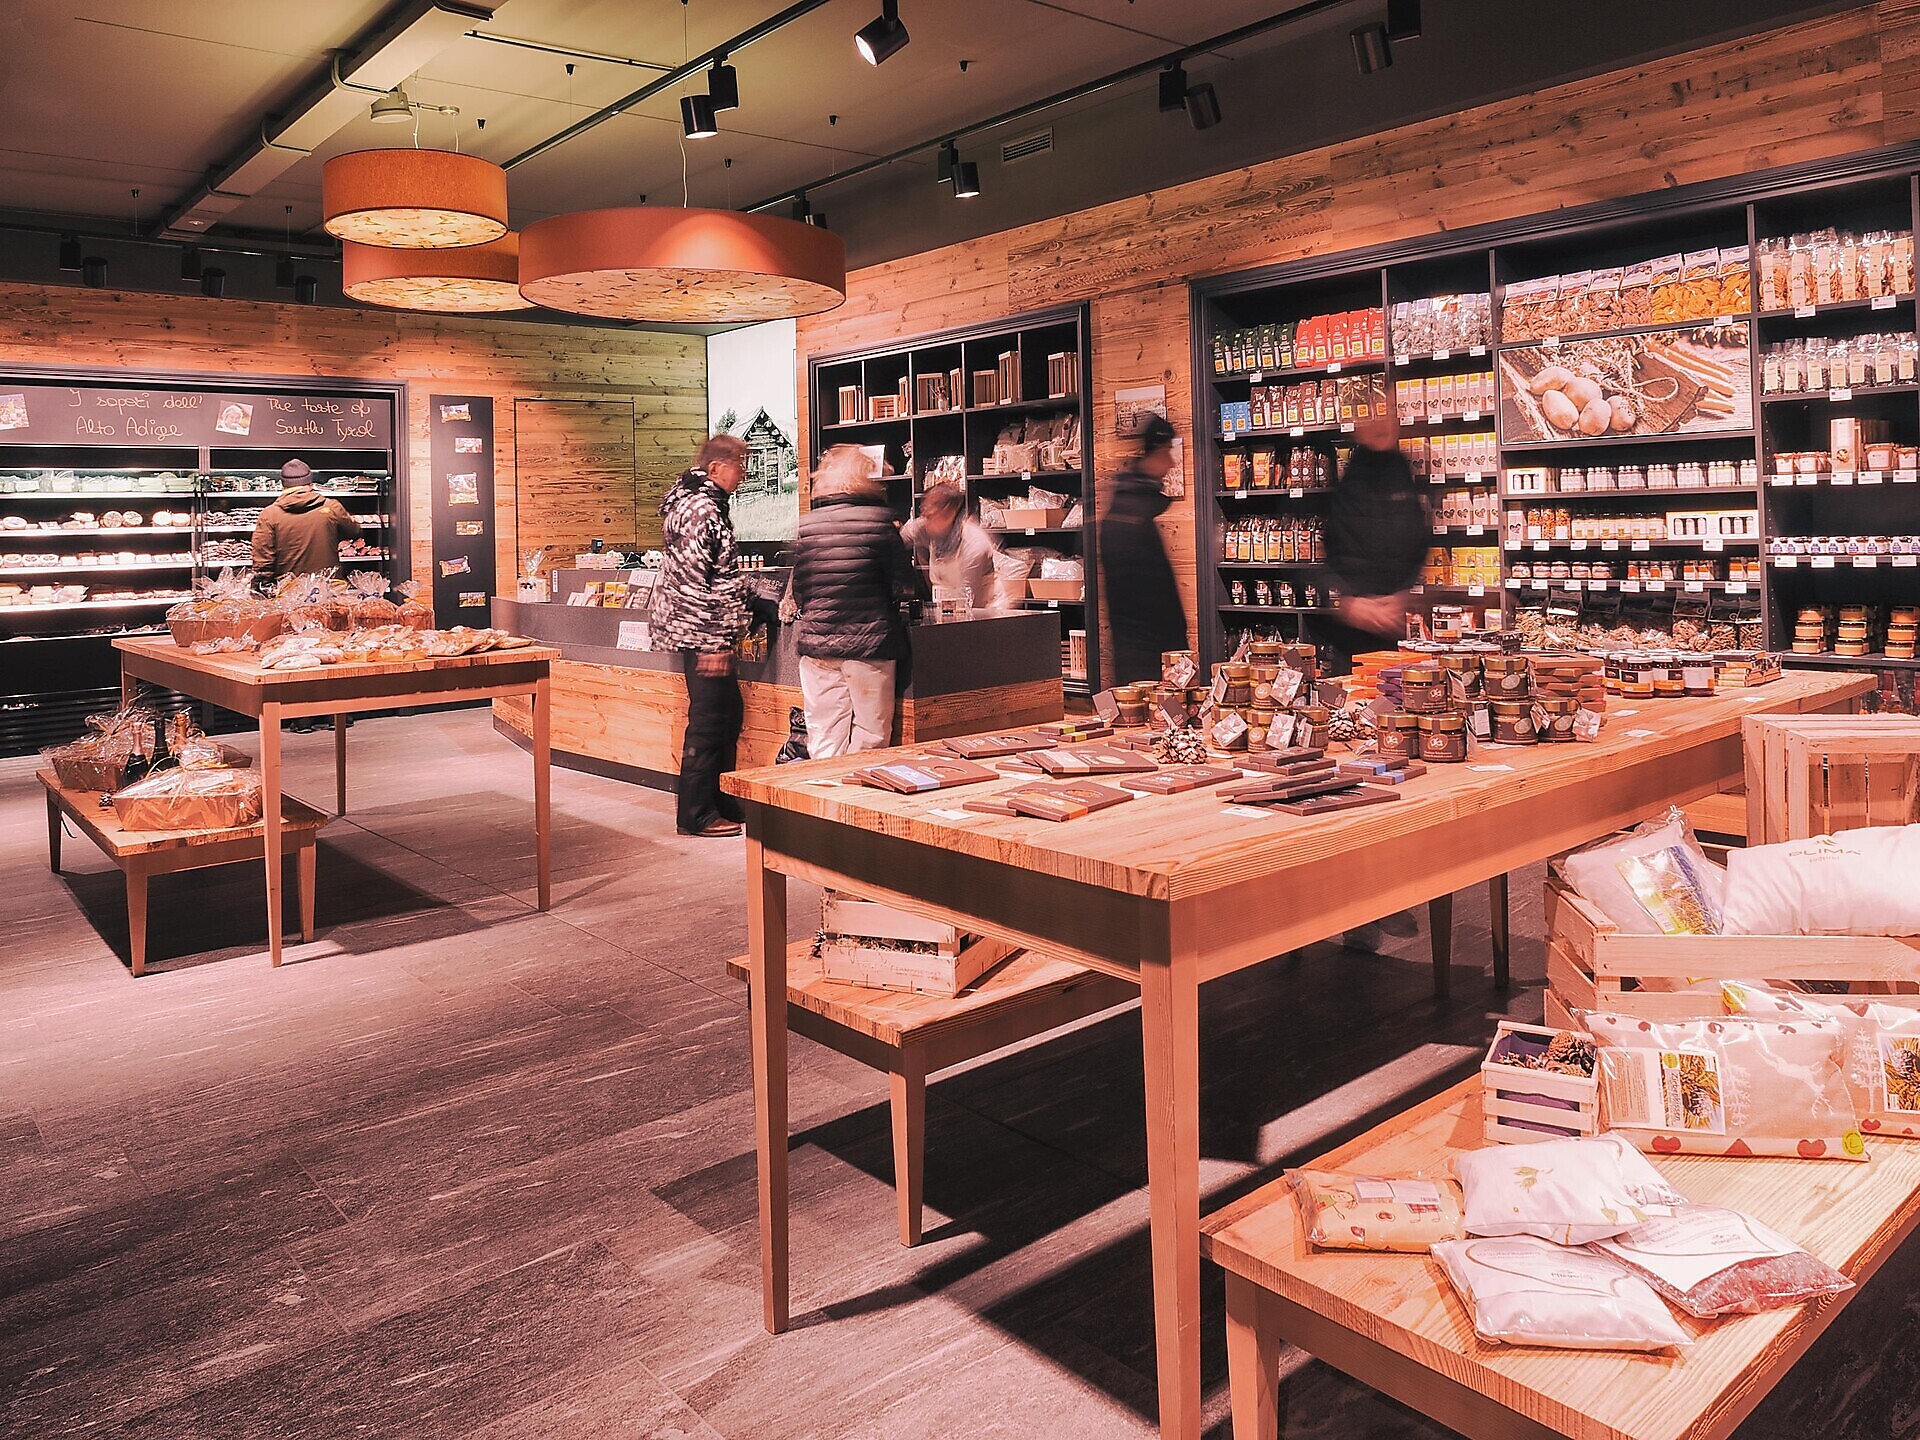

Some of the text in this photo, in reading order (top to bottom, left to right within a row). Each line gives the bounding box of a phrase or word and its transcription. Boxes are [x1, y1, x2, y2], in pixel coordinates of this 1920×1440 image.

[162, 395, 203, 409] dell'
[266, 397, 371, 417] The taste of
[76, 416, 184, 441] Alto Adige
[275, 418, 377, 442] South Tyrol
